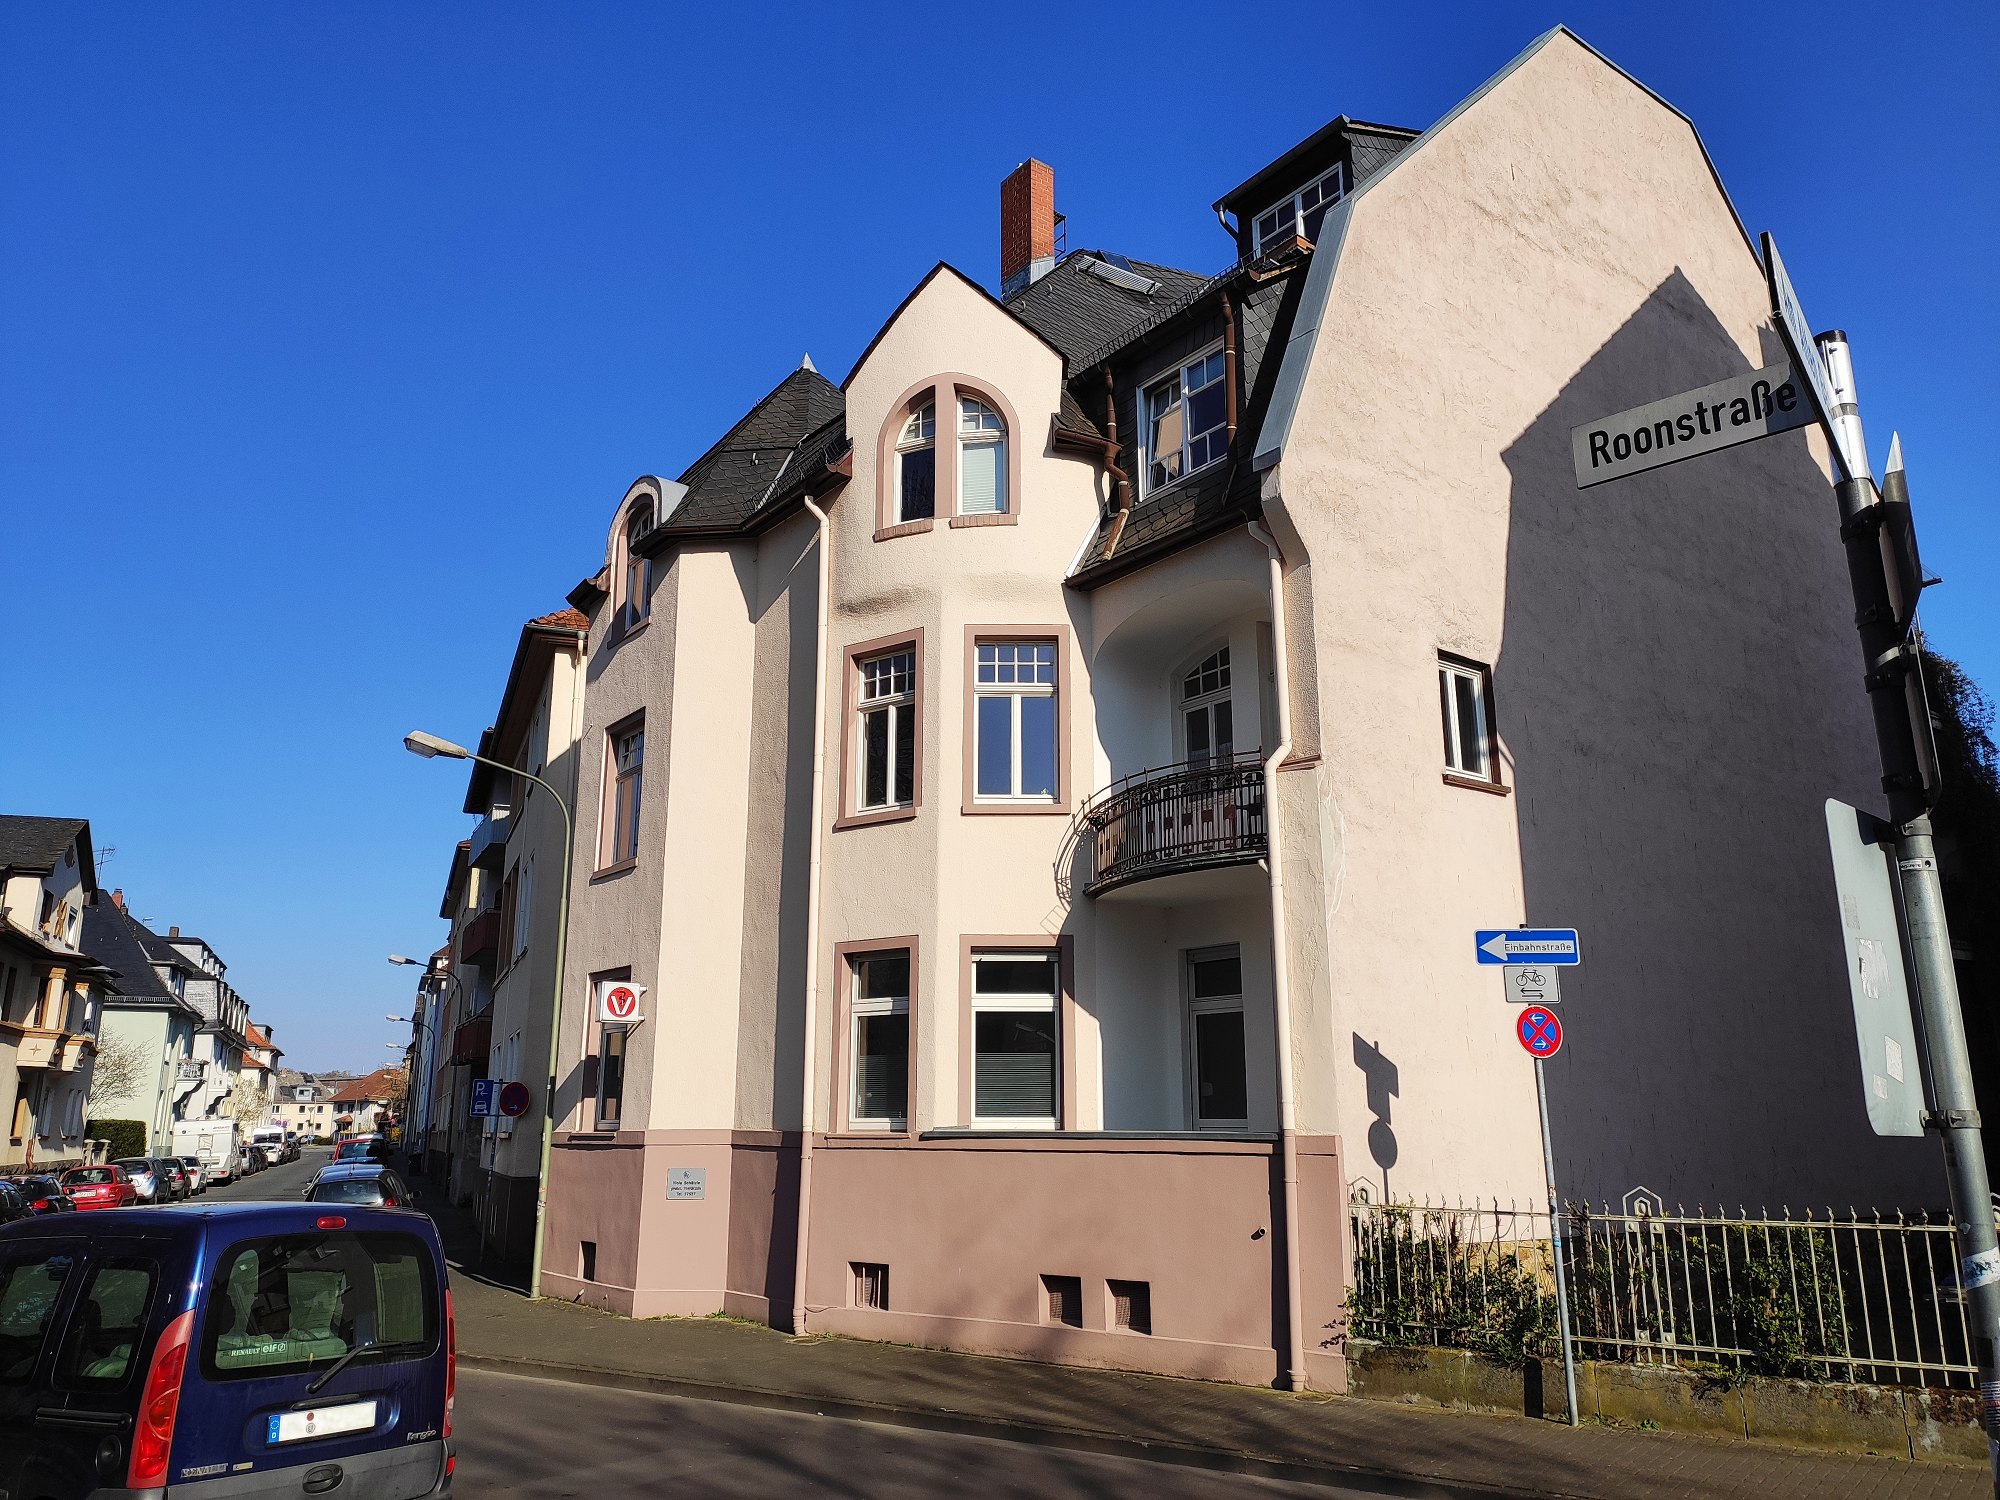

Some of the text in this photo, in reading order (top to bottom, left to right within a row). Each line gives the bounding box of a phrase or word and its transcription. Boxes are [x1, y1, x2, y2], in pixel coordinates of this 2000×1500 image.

[1588, 380, 1798, 469] Roonstraße
[1504, 943, 1572, 952] Einbahnstraße
[475, 1082, 486, 1096] P
[231, 1348, 260, 1356] RENAULT
